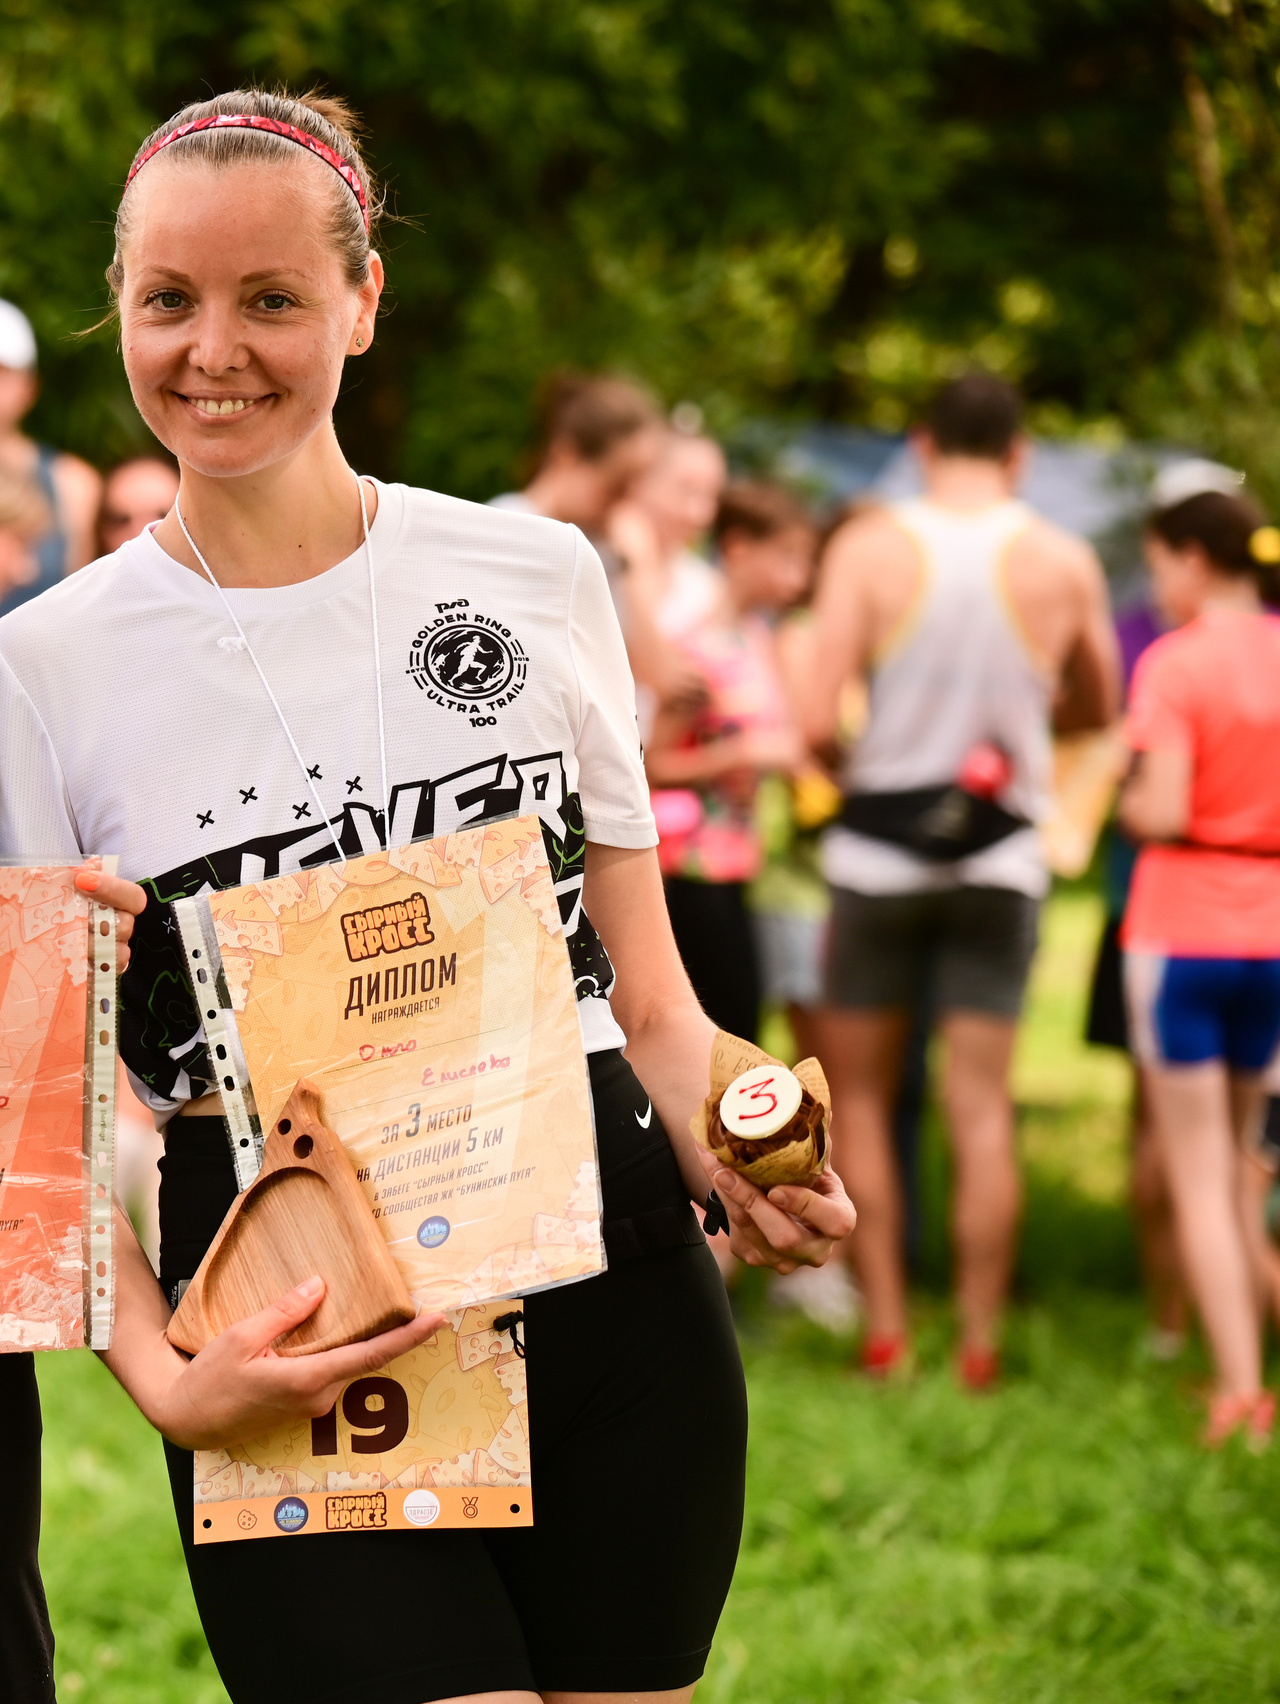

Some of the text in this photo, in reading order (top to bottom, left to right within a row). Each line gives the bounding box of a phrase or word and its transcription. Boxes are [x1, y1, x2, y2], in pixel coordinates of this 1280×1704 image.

[411, 612, 512, 649] GOLDEN RING
[426, 682, 525, 714] ULTRA TRAIL
[469, 716, 497, 728] 100
[342, 893, 429, 935] СЫРНЫЙ
[346, 916, 433, 961] КРОСС
[344, 952, 457, 1020] ДИПЛОМ
[371, 996, 440, 1025] НАГРАЖДАЕТСЯ
[738, 1077, 778, 1121] 3
[381, 1102, 473, 1145] ЗА 3 МЕСТО
[356, 1126, 505, 1183] НА ДИСТАНЦИИ 5 КМ
[381, 1182, 411, 1200] ЗАБЕГЕ
[382, 1192, 439, 1217] СООБЩЕСТВА
[439, 1188, 454, 1202] ЖК
[311, 1376, 410, 1457] 19
[326, 1492, 386, 1511] СЫРНЫЙ
[326, 1508, 387, 1529] КРОСС
